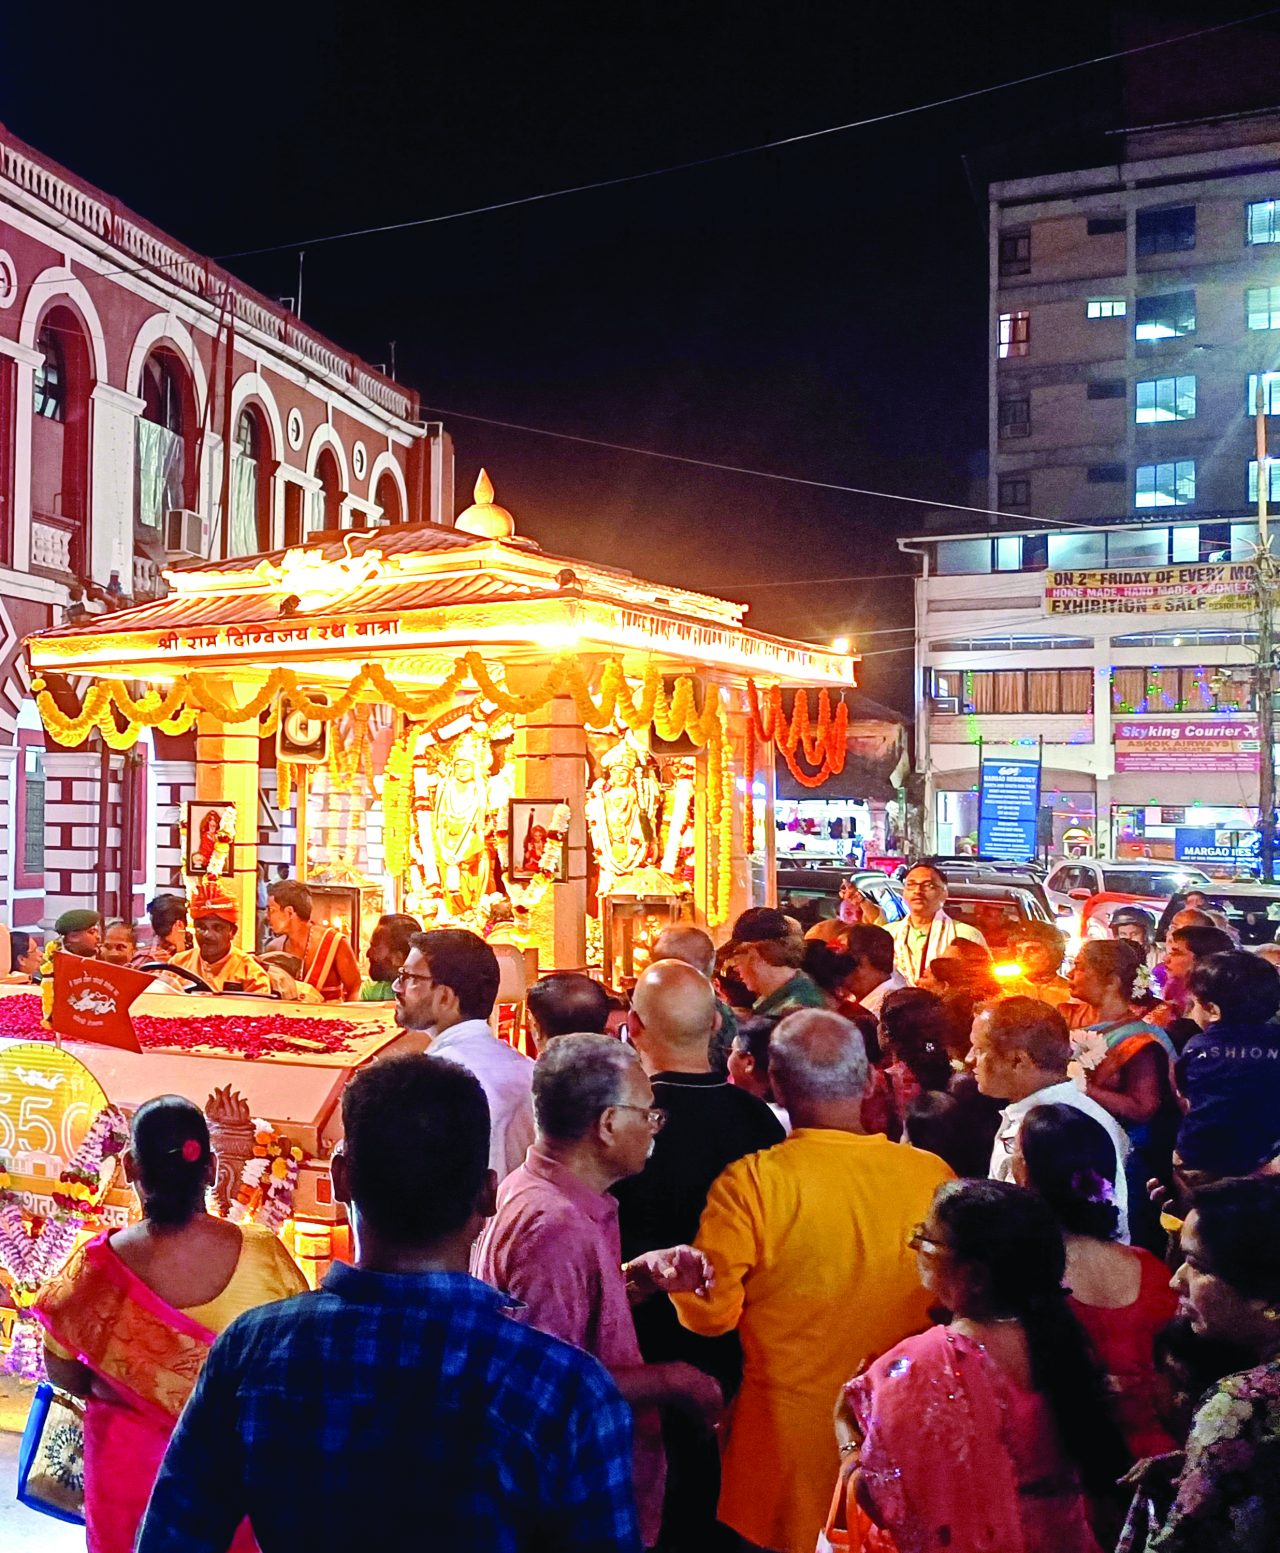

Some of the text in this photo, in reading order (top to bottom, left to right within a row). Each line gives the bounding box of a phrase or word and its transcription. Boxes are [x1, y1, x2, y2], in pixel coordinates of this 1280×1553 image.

[1054, 572, 1073, 586] ON
[1100, 571, 1150, 585] FRIDAY
[1155, 570, 1174, 583] OF
[1179, 566, 1224, 582] EVERY
[1053, 588, 1083, 597] HOME
[1124, 587, 1153, 596] HAND
[1052, 599, 1147, 614] EXHIBITION
[1165, 597, 1206, 612] SALE
[158, 619, 399, 651] श्री राम दिग्विजय रथ यात्रा
[1121, 725, 1241, 739] Skyking Courier
[1184, 846, 1229, 856] MARGAO
